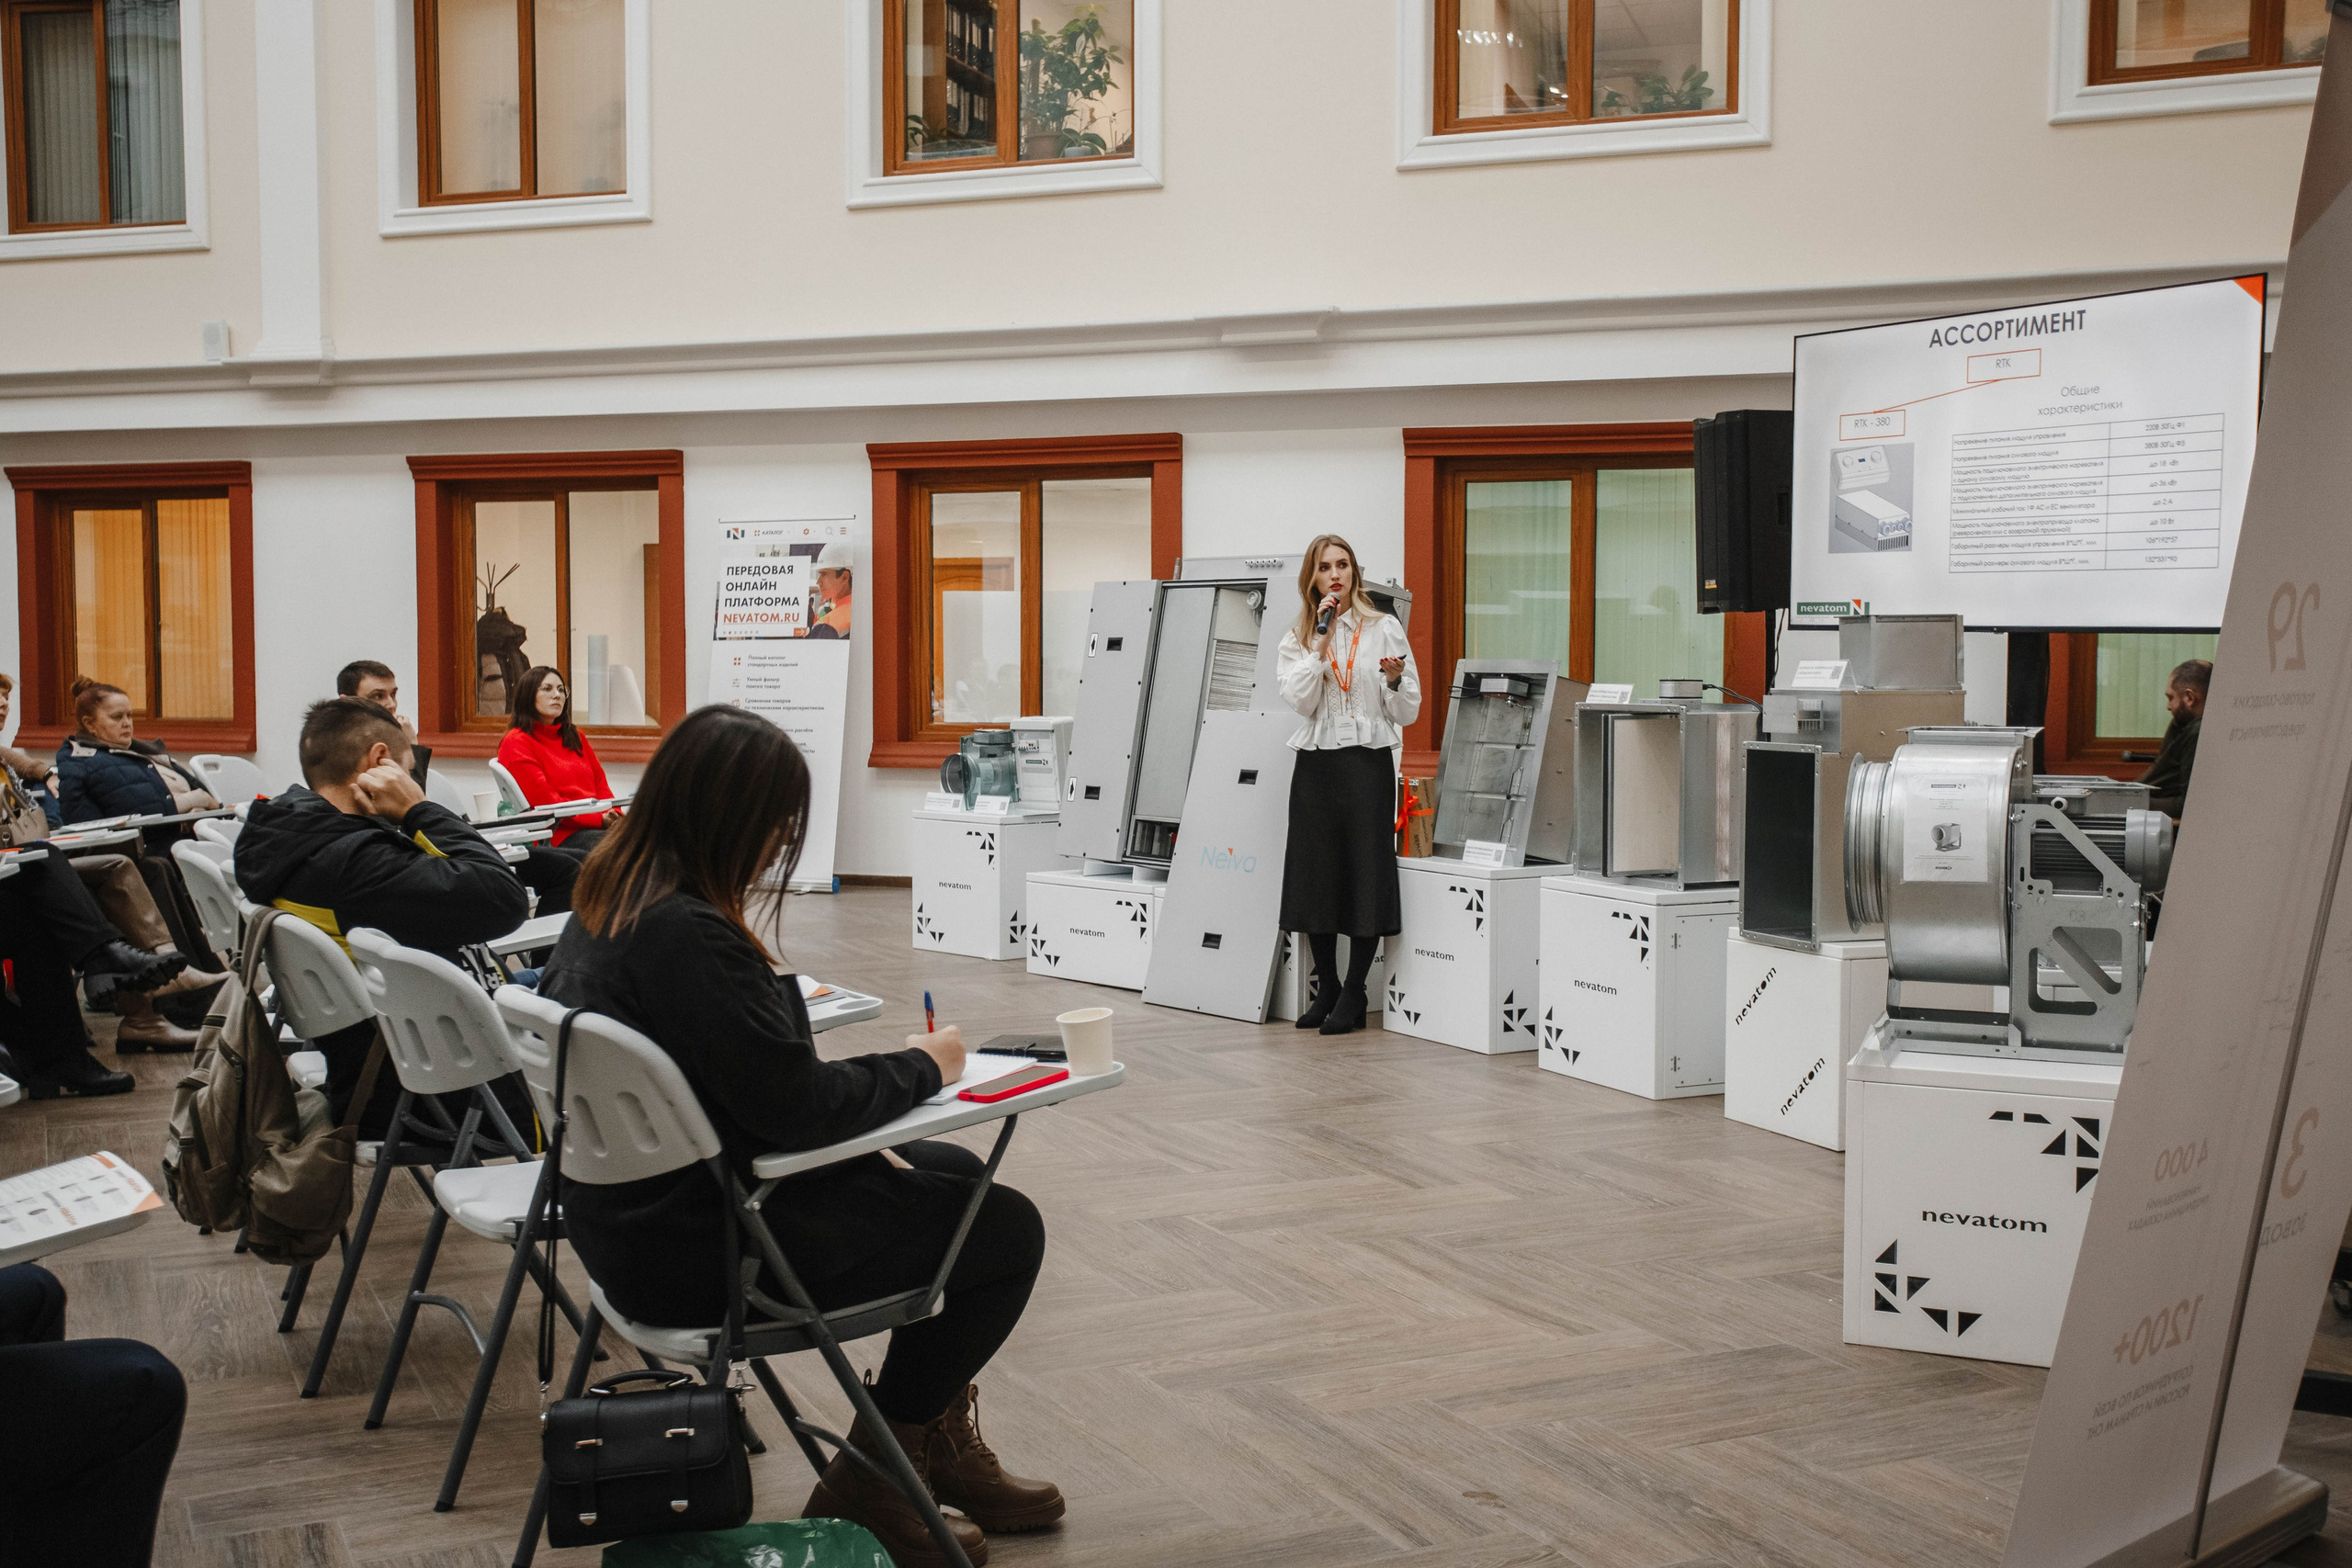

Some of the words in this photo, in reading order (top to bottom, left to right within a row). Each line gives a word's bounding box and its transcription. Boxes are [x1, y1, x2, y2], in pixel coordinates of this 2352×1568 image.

[1929, 310, 2086, 348] АССОРТИМЕНТ
[1996, 358, 2011, 368] RTK
[2061, 386, 2099, 397] Общие
[2038, 400, 2122, 416] характеристики
[1854, 419, 1868, 429] RTK
[1876, 417, 1891, 426] 380
[727, 565, 794, 576] ПЕРЕДОВАЯ
[726, 579, 777, 592] ОНЛАЙН
[725, 597, 800, 608] ПЛАТФОРМА
[1800, 604, 1848, 613] nevatom
[723, 613, 800, 625] NEVATOM.RU
[1200, 846, 1258, 874] Neiva
[939, 881, 972, 891] nevatom
[1070, 927, 1105, 939] nevatom
[1415, 948, 1454, 962] nevatom
[1574, 979, 1618, 996] nevatom
[1735, 967, 1777, 1025] nevatom
[1781, 1058, 1826, 1115] nevatom
[1922, 1211, 2048, 1234] nevatom
